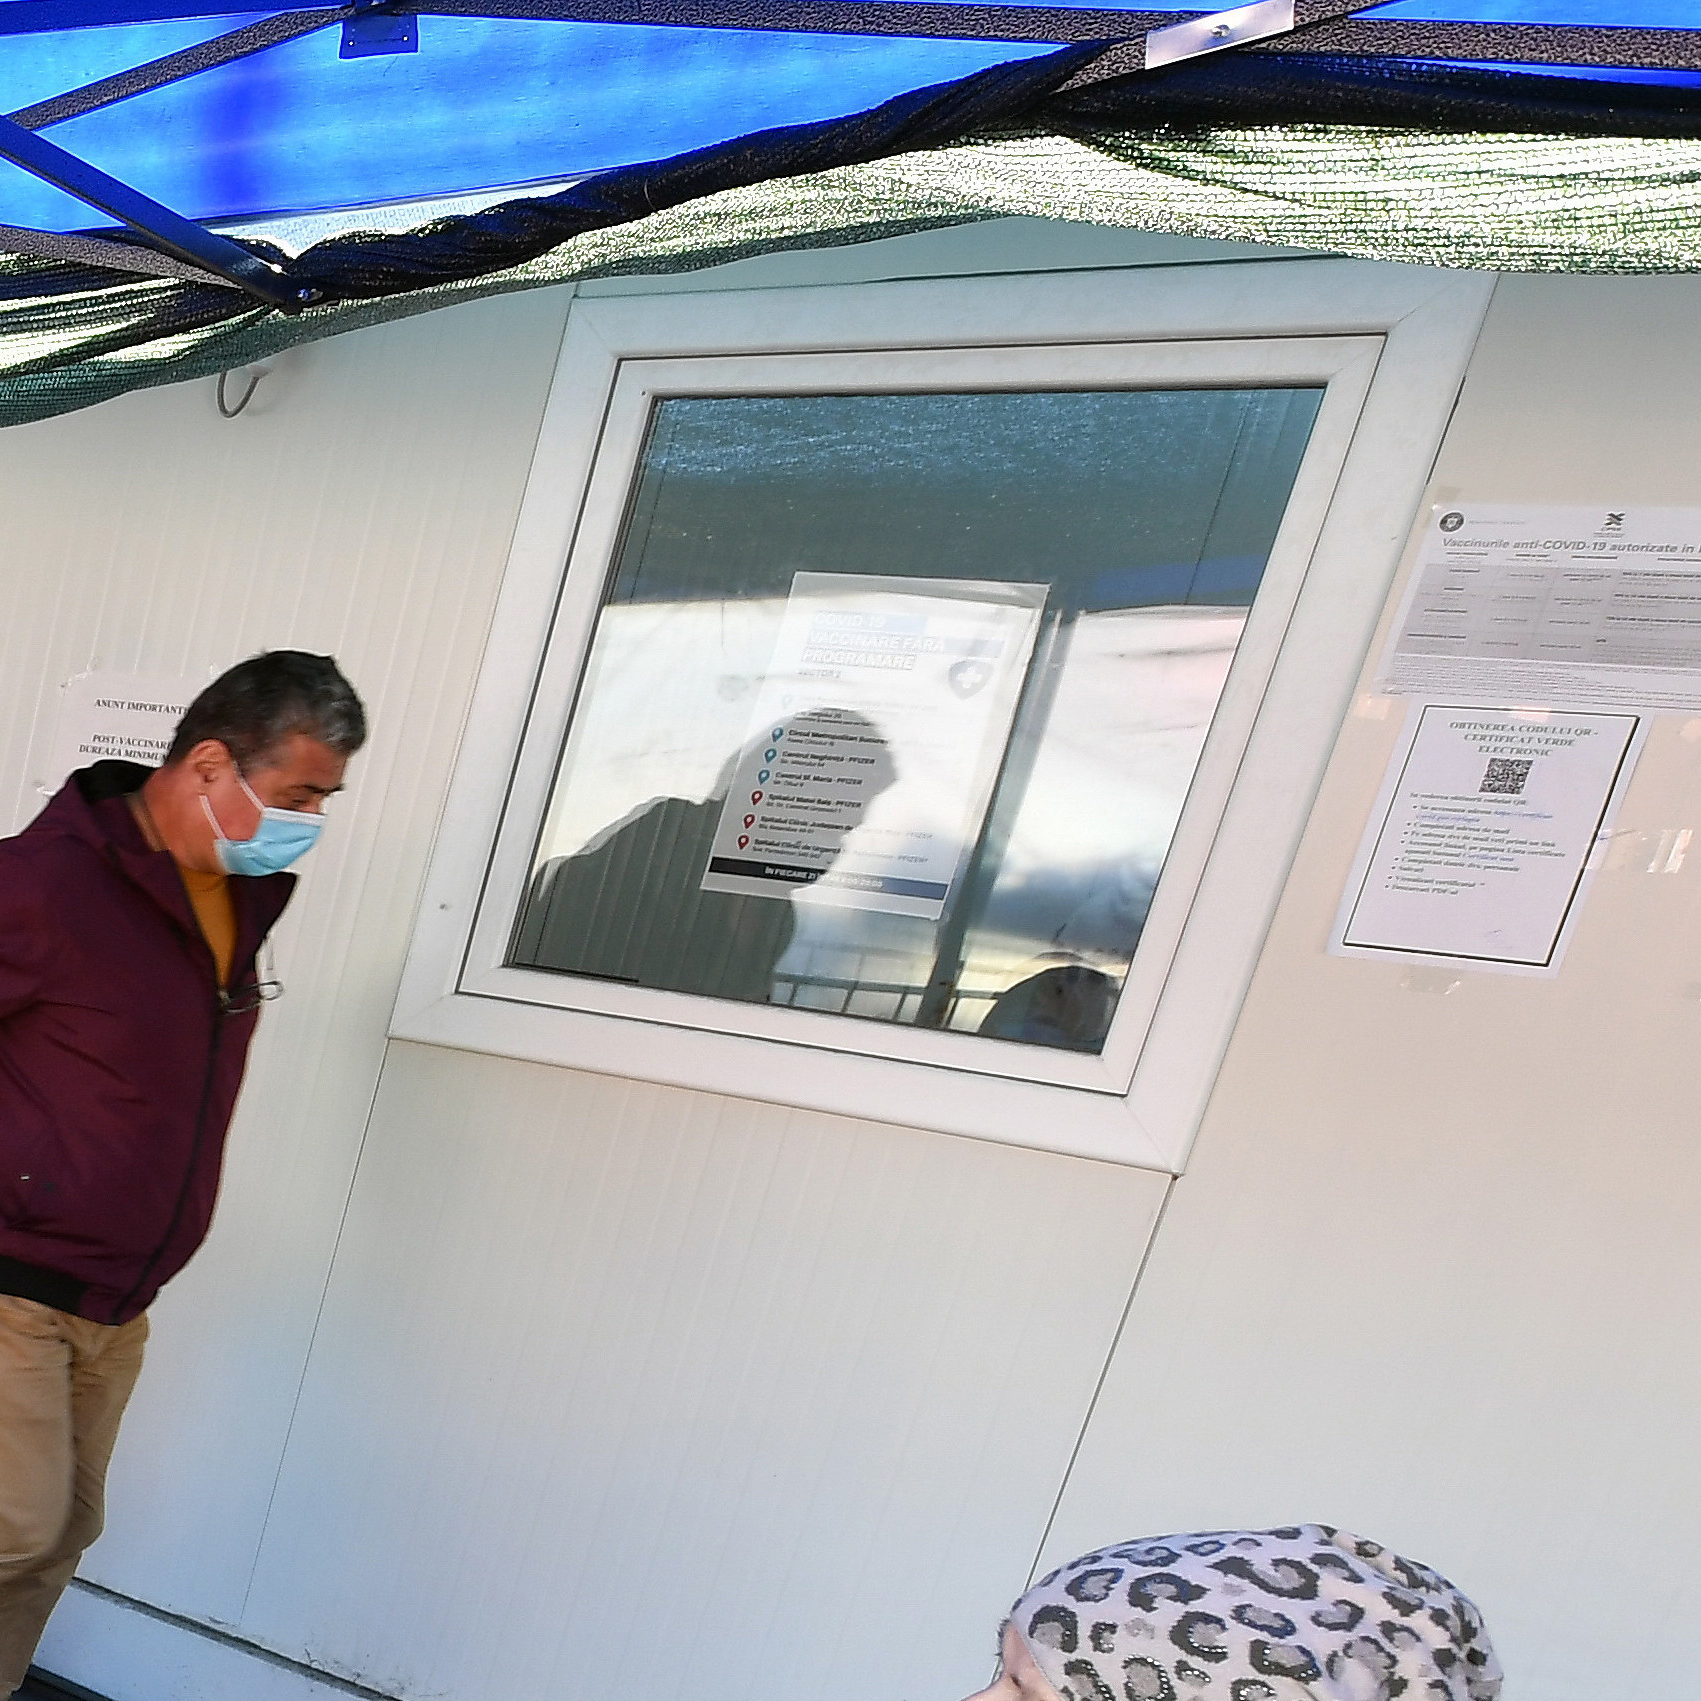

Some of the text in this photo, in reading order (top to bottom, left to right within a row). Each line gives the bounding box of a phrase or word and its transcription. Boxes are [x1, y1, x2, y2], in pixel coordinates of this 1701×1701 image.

[1513, 541, 1606, 551] anti-COVID-19
[1464, 734, 1576, 746] CERTIFICAT VERDE
[1478, 745, 1553, 755] ELECTRONIC
